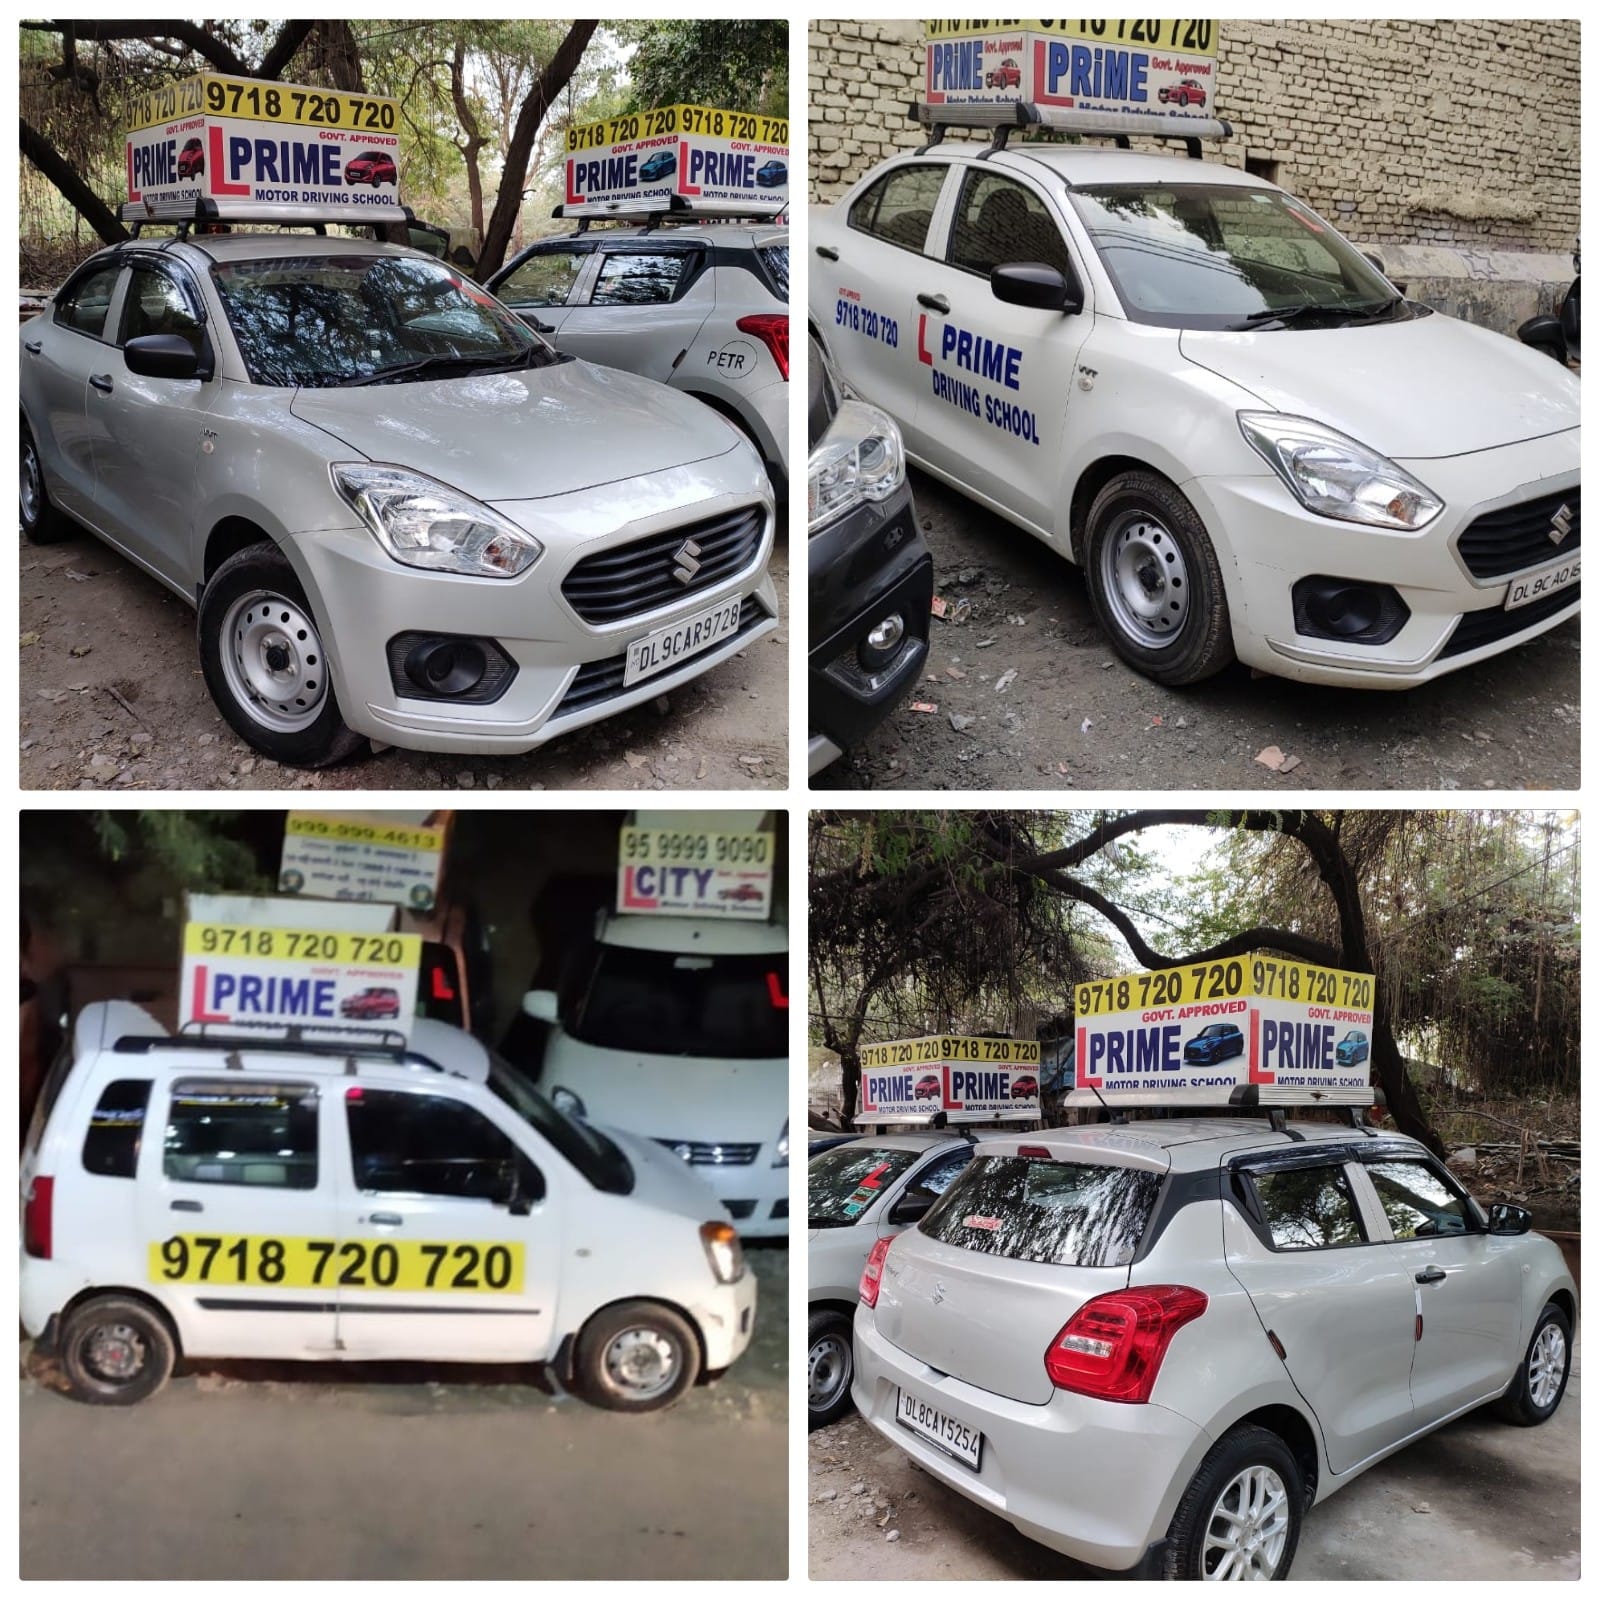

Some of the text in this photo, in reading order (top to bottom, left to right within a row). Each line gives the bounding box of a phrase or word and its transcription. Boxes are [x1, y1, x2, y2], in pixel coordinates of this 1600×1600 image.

[927, 45, 944, 104] L
[1033, 39, 1074, 108] L
[126, 78, 203, 128] 9718 720 720
[207, 81, 394, 130] 9718 720 720
[682, 108, 788, 144] 9718 720 720
[319, 131, 397, 146] GOVT. APPROVED
[569, 109, 676, 151] 9718 720 720
[612, 135, 679, 154] GOVT. APPROVED
[731, 141, 789, 156] GOVT. APPROVED
[127, 139, 177, 202] L PRIME
[209, 126, 342, 196] L PRIME
[566, 154, 638, 205] L PRIME
[678, 141, 755, 195] L PRIME
[256, 189, 395, 205] MOTOR DRIVING SCHOOL
[836, 299, 898, 348] 9718 720 720
[707, 351, 745, 369] PETR
[918, 313, 1023, 391] L PRIME
[932, 368, 1040, 446] DRIVING SCHOOL
[1513, 584, 1528, 602] DL
[639, 603, 739, 672] DL9CAR9728
[626, 833, 767, 863] 95 9999 9090
[624, 865, 715, 909] L CITY
[202, 928, 403, 963] 9718 720 720
[192, 965, 336, 1024] L PRIME
[1079, 961, 1243, 1015] 9718 720 720
[1253, 961, 1370, 1009] 9718 720 720
[1142, 1000, 1247, 1023] GOVT. APPROVED
[1308, 1007, 1371, 1024] GOVT. APPROVED
[862, 1041, 939, 1065] 9718 720 720
[942, 1039, 1038, 1060] 9718 720 720
[1077, 1025, 1181, 1088] L PRIME
[1249, 1009, 1335, 1084] L PRIME
[863, 1074, 913, 1111] L PRIME
[943, 1066, 1010, 1109] L PRIME
[161, 1235, 512, 1289] 9718 720 720
[906, 1396, 978, 1456] DL8CAY5254
